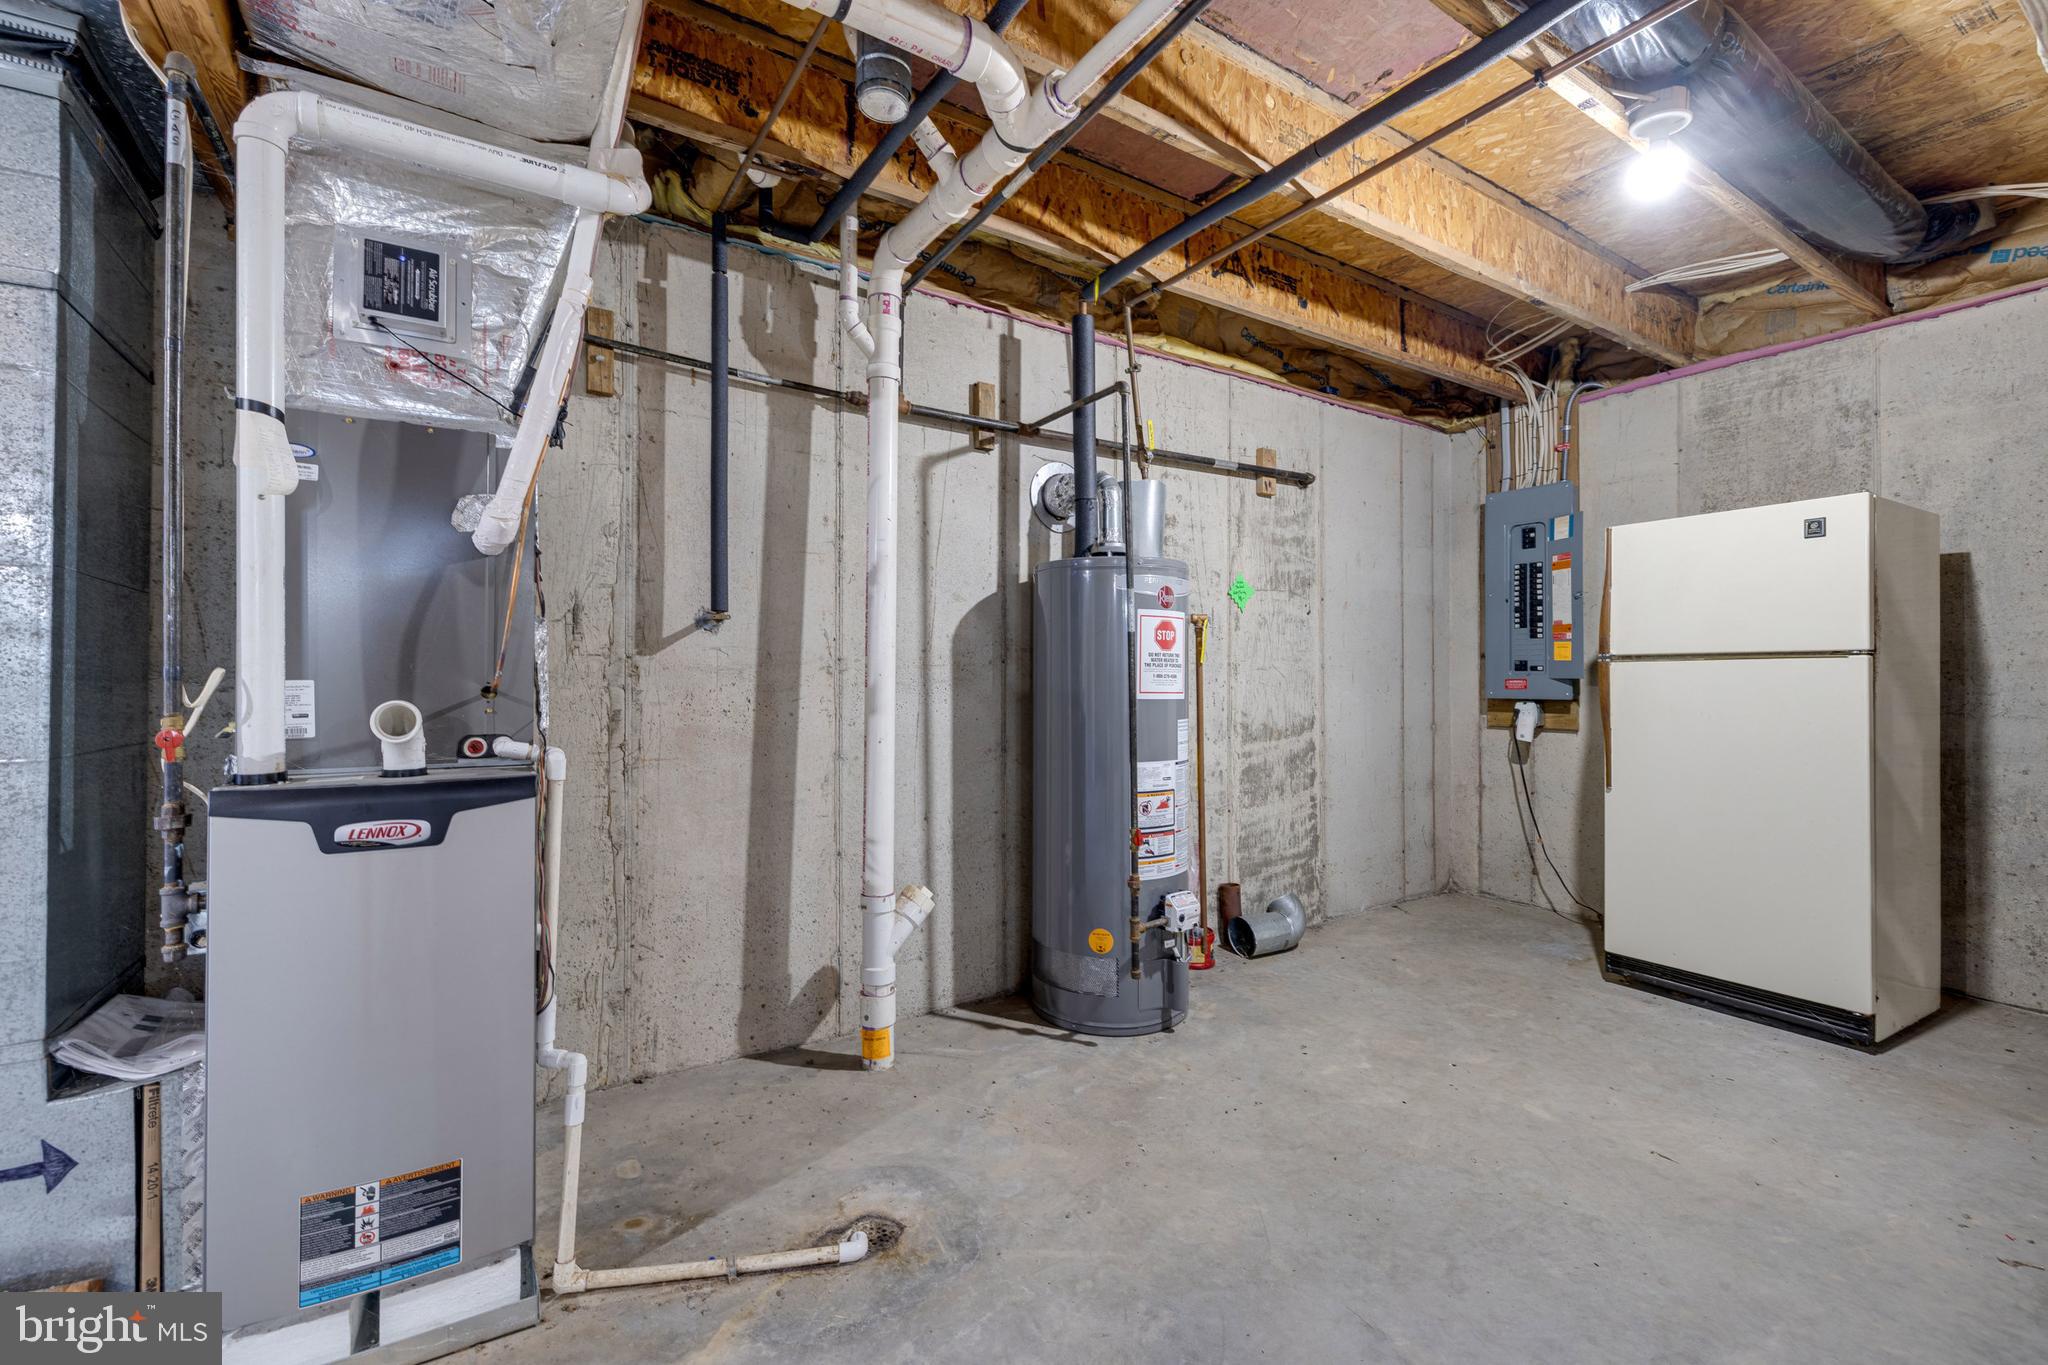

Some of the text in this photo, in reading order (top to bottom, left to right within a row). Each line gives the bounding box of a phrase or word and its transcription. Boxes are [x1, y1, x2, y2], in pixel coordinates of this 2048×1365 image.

[428, 279, 438, 312] Scrubber
[1156, 630, 1175, 641] STOP
[347, 825, 408, 841] LENNOX
[148, 1087, 159, 1128] Filtrete
[312, 1187, 352, 1202] WARNING
